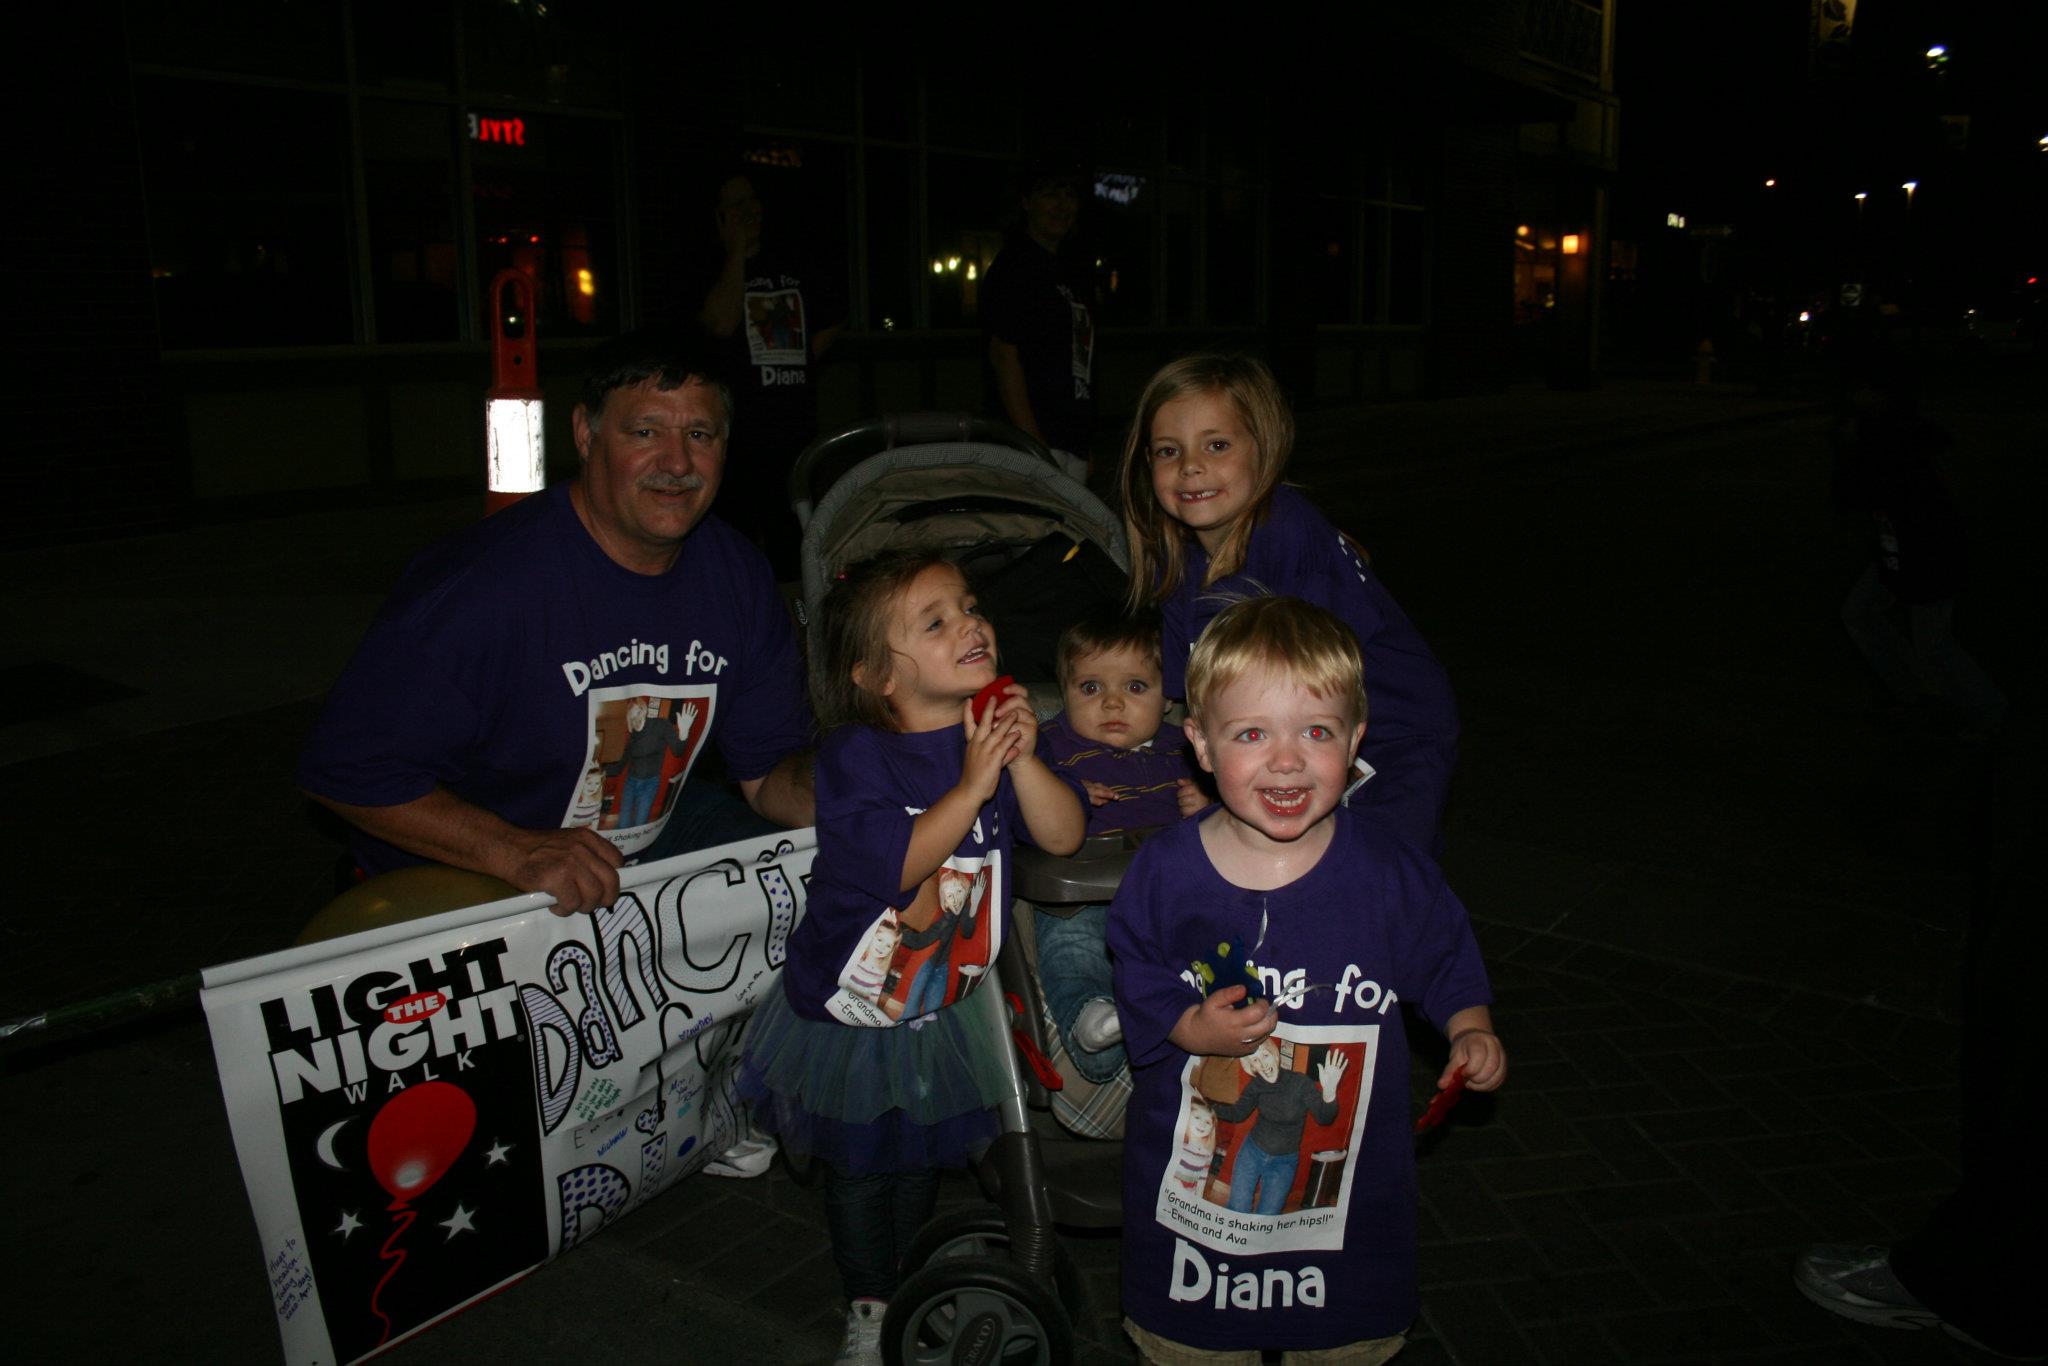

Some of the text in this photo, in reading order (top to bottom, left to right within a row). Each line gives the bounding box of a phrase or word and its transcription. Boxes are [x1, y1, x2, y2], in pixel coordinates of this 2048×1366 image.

[760, 365, 807, 386] Diana
[562, 638, 729, 698] Dancing for
[260, 937, 509, 1053] LIGHT
[387, 994, 441, 1022] THE
[1335, 963, 1399, 1015] for
[271, 984, 519, 1105] NIGHT
[344, 1049, 476, 1105] WALK
[1162, 1208, 1248, 1246] --Emma and Ava
[1164, 1188, 1335, 1234] "Grandma is shaking her hips!!"
[1168, 1236, 1326, 1311] Diana
